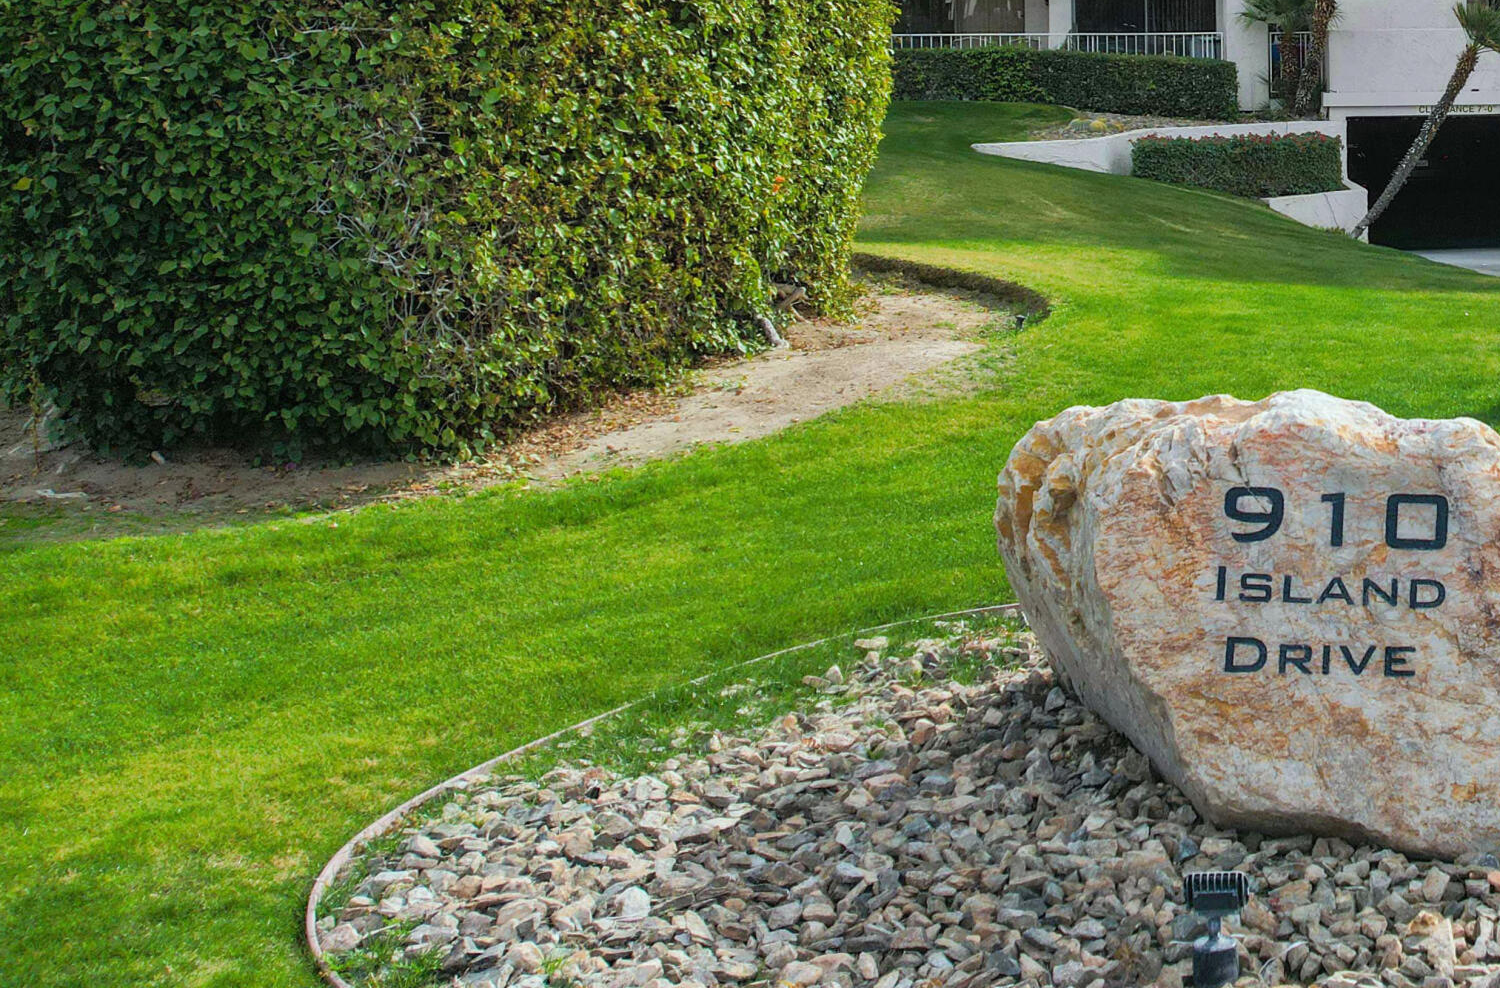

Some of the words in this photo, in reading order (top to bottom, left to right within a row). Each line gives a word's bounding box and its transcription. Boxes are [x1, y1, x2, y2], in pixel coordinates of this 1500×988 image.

[1418, 104, 1475, 113] CLANCE
[1224, 486, 1449, 550] 910
[1215, 566, 1446, 609] ISLAND
[1224, 636, 1416, 677] DRIVE
